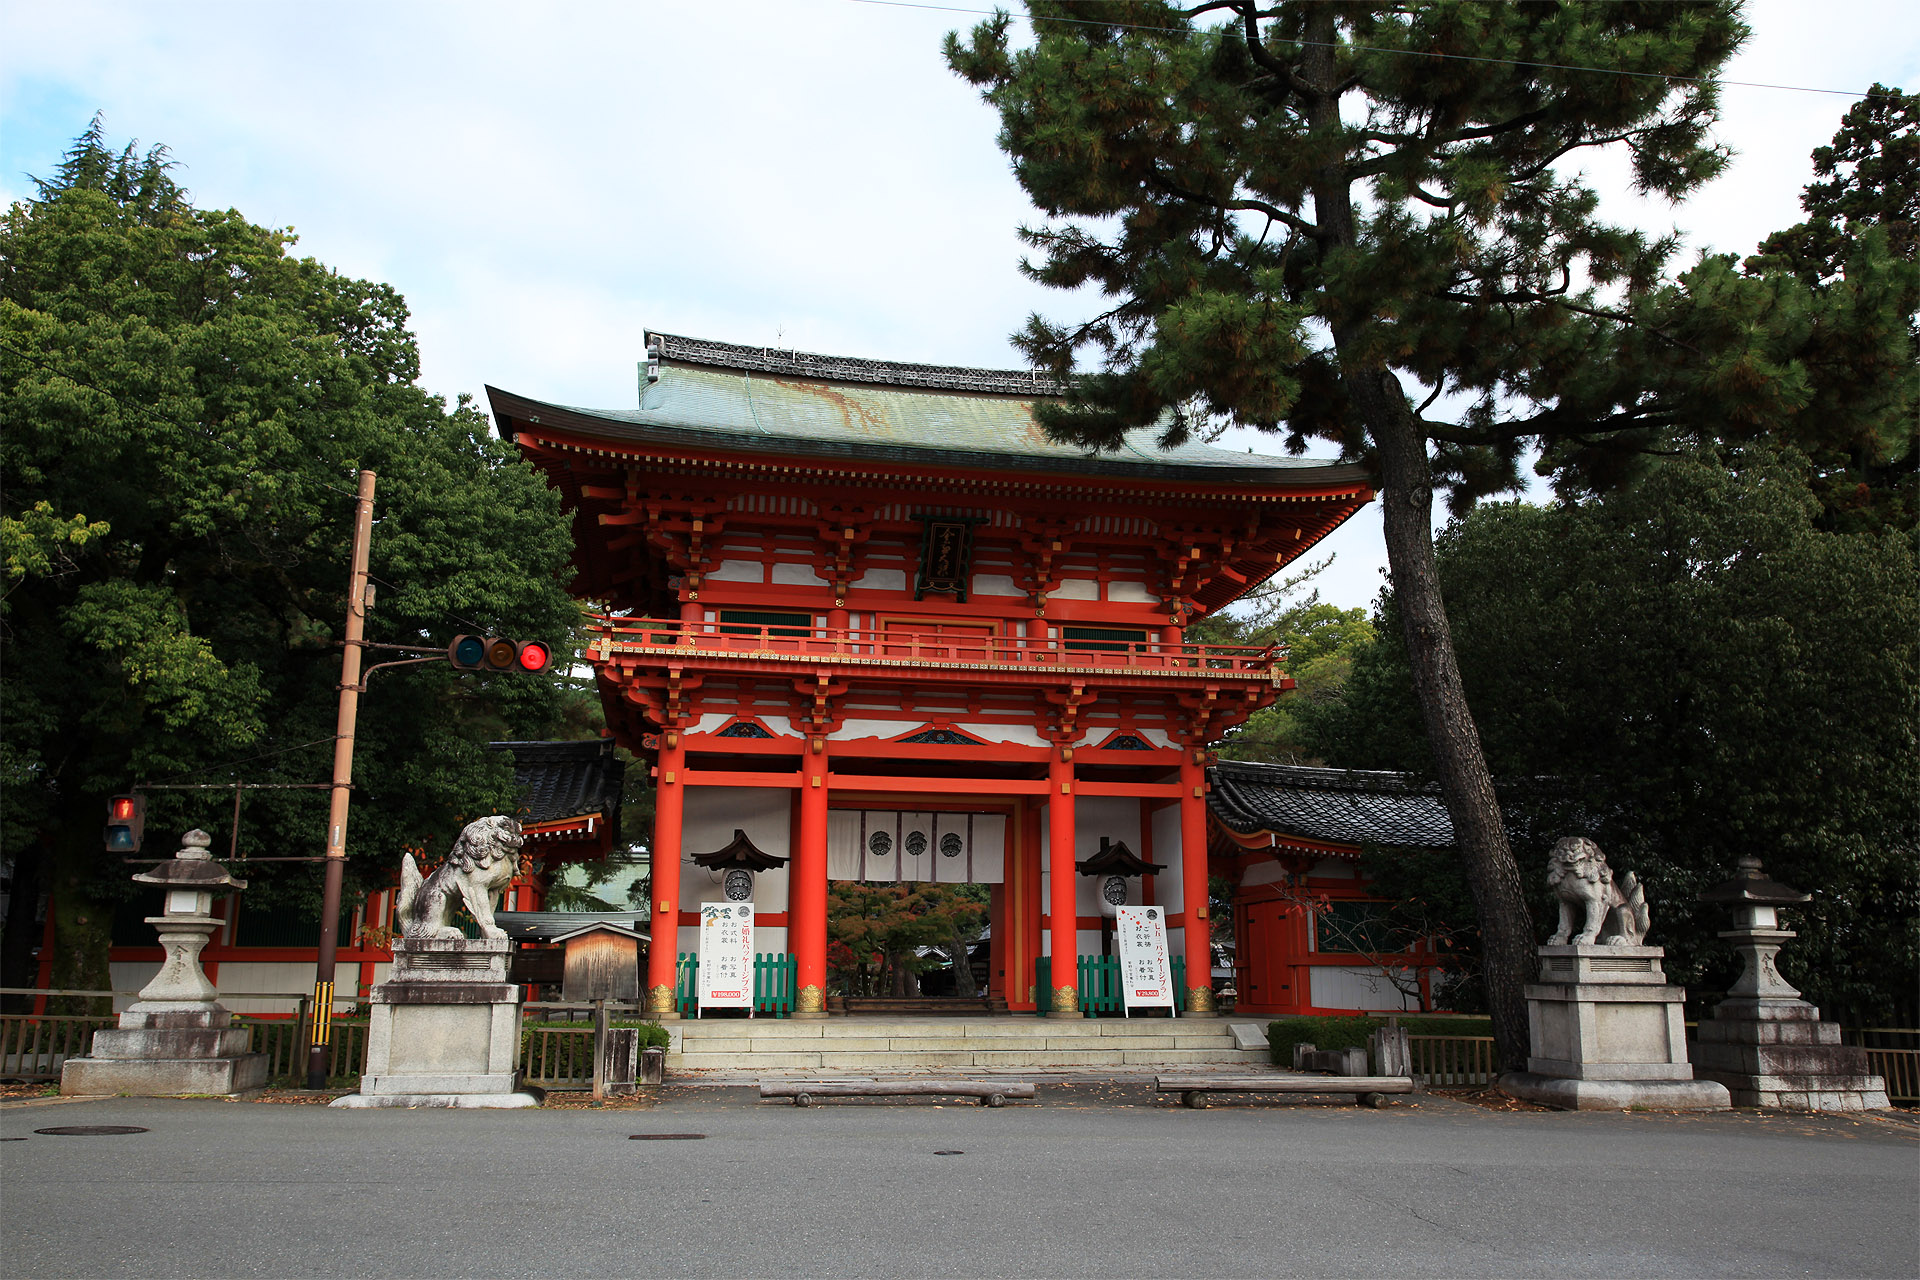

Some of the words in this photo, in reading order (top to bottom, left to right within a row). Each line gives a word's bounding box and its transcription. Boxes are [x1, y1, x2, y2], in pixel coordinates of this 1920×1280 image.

[720, 956, 728, 978] お着付
[729, 956, 737, 978] お写真
[741, 920, 750, 1002] ご婚礼パッケージプラン
[1147, 959, 1155, 980] お写真
[1155, 922, 1167, 1000] 七五三パッケージプラン
